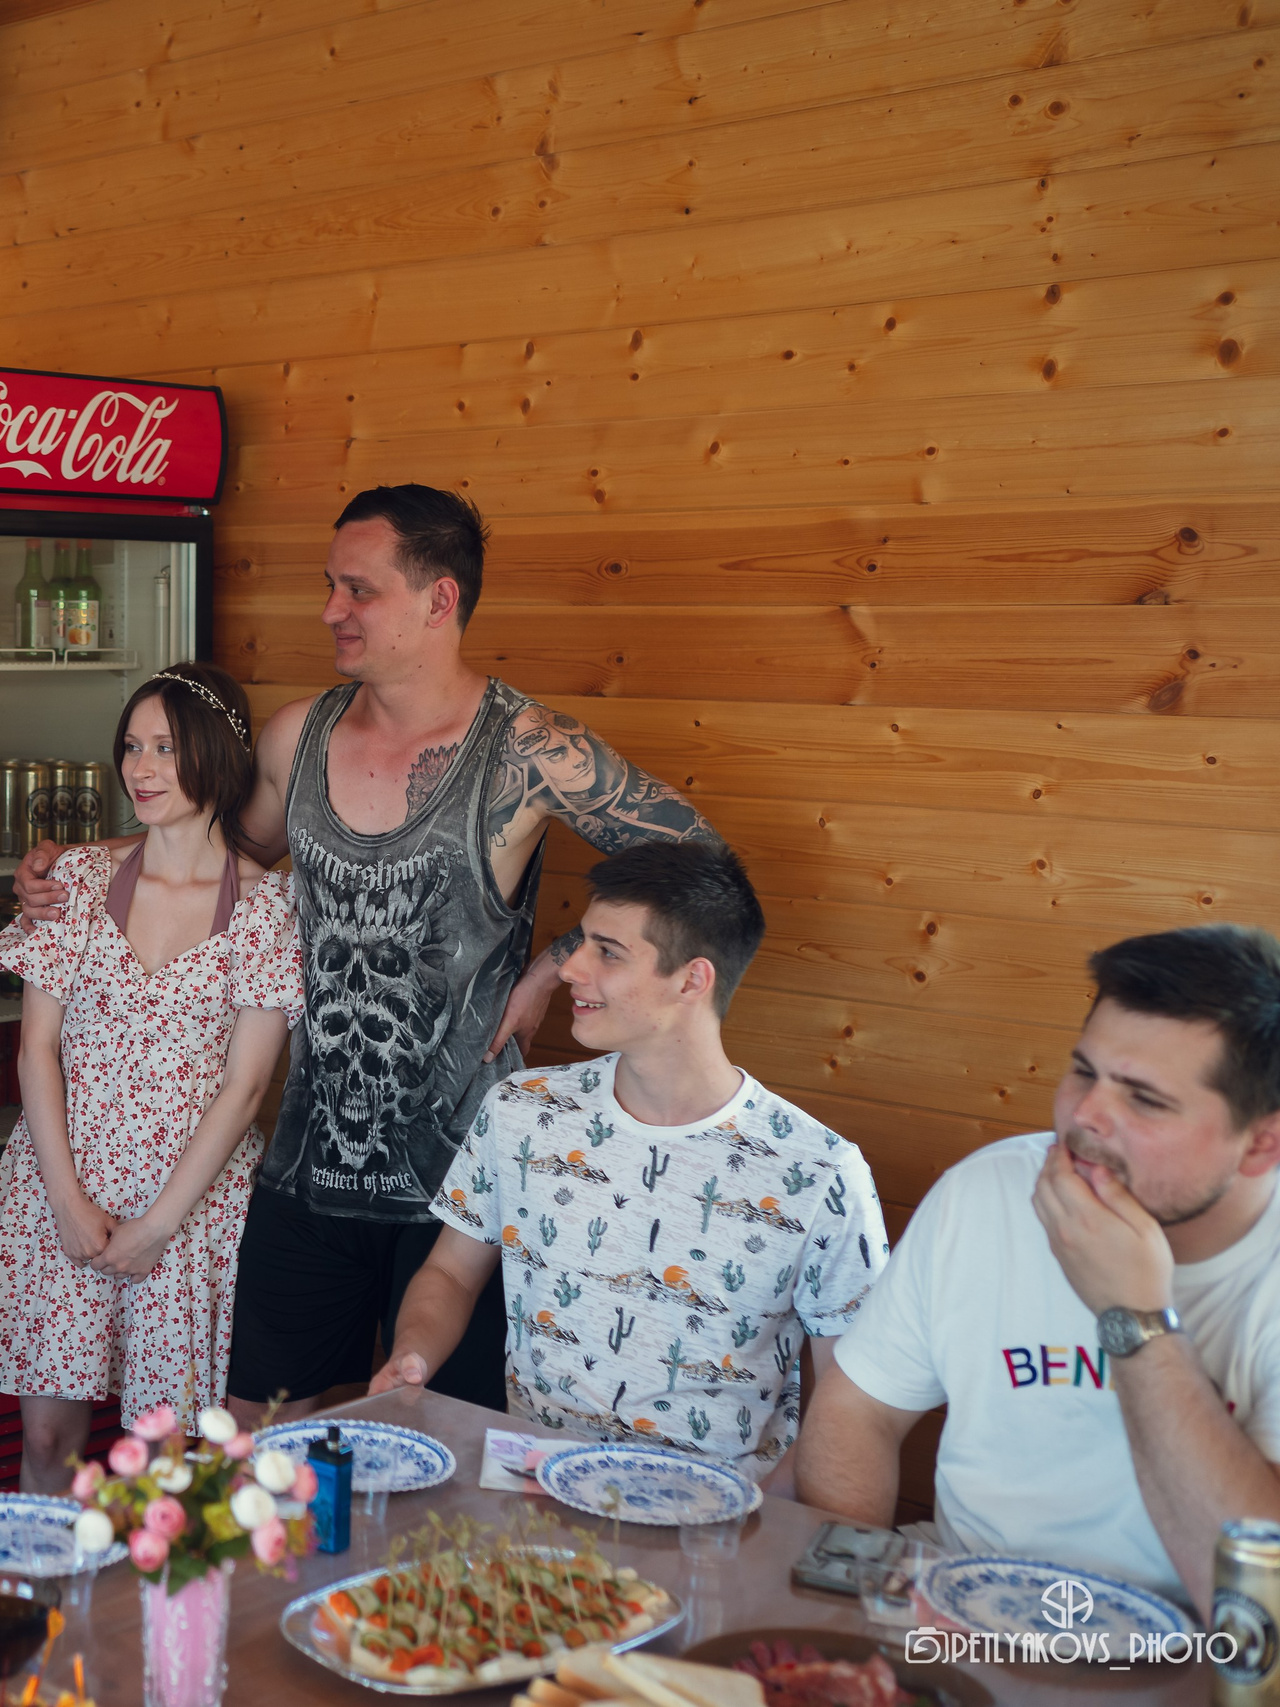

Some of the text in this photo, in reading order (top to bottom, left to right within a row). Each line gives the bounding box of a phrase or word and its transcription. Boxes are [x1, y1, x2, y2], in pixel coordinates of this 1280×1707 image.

[363, 1171, 377, 1194] of
[380, 1171, 412, 1195] hate
[1002, 1344, 1117, 1391] BEN
